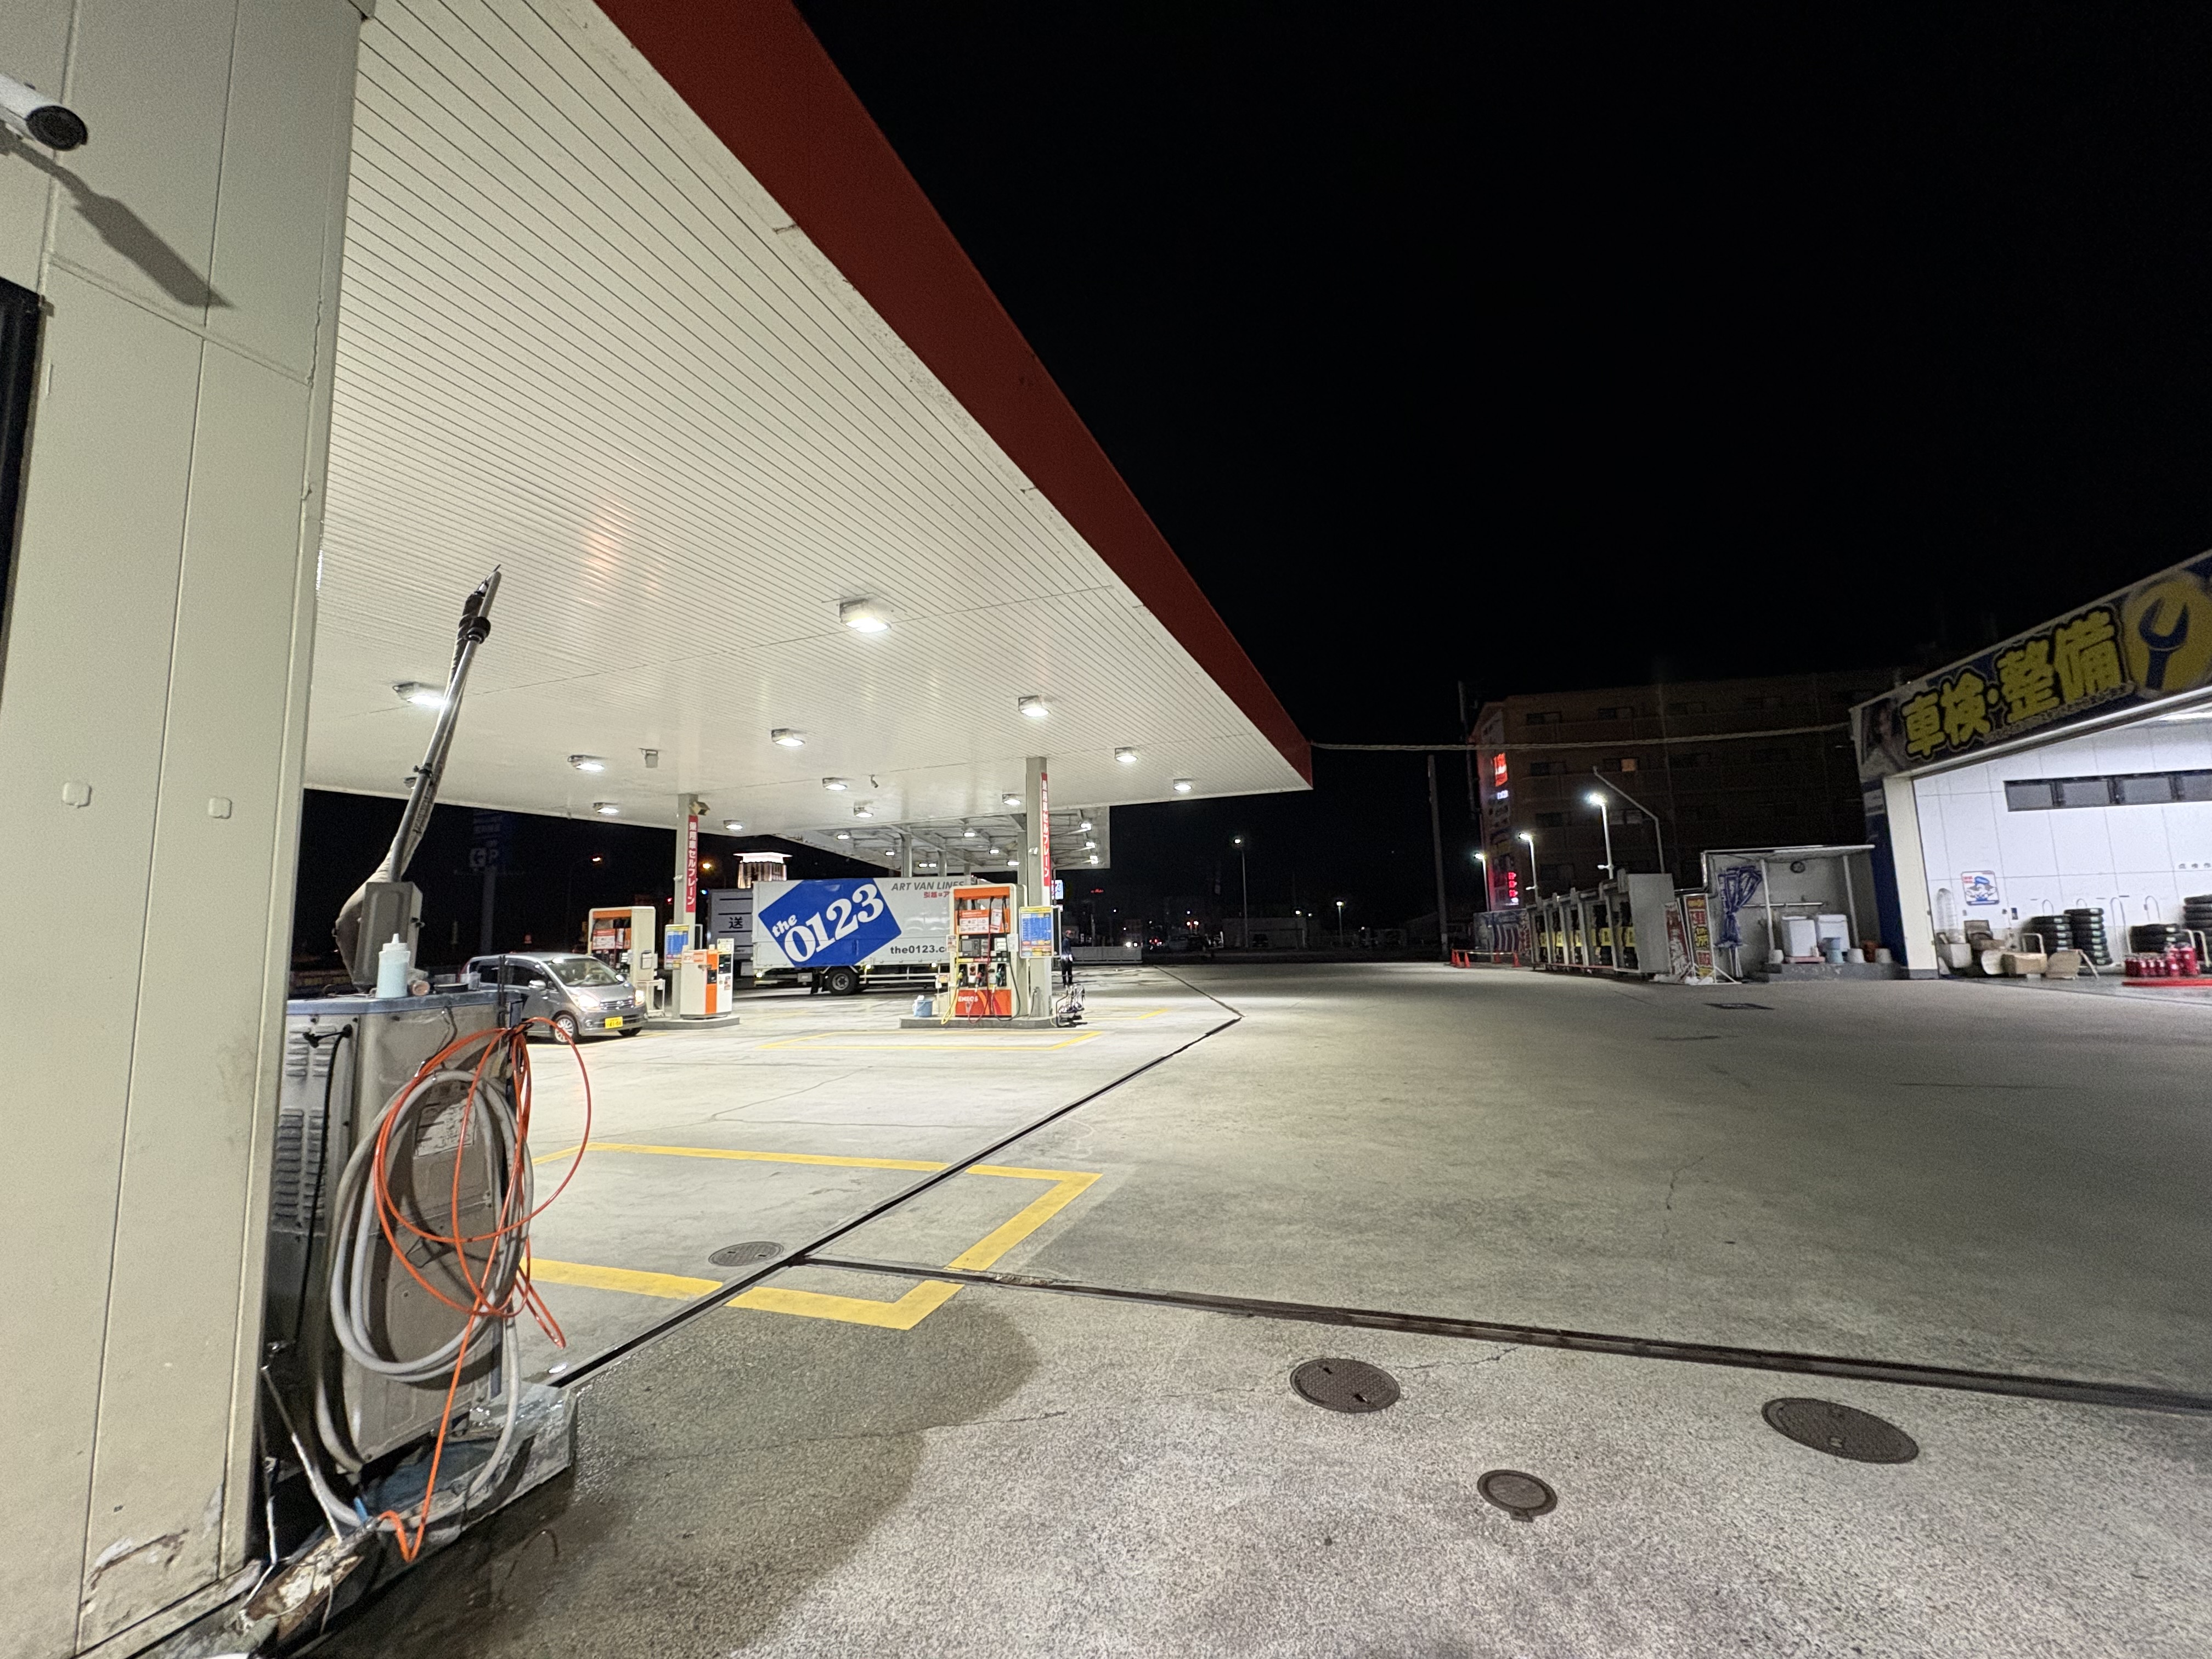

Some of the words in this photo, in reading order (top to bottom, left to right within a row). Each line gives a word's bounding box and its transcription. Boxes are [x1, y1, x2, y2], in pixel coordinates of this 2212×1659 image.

[1902, 610, 2122, 756] 車検・整備
[687, 822, 697, 905] 乗用車セルフレーン
[891, 883, 911, 891] ART
[913, 882, 934, 890] VAN
[729, 917, 743, 928] 送
[772, 915, 797, 937] the
[785, 884, 883, 962] 0123
[890, 945, 946, 953] the0123.c
